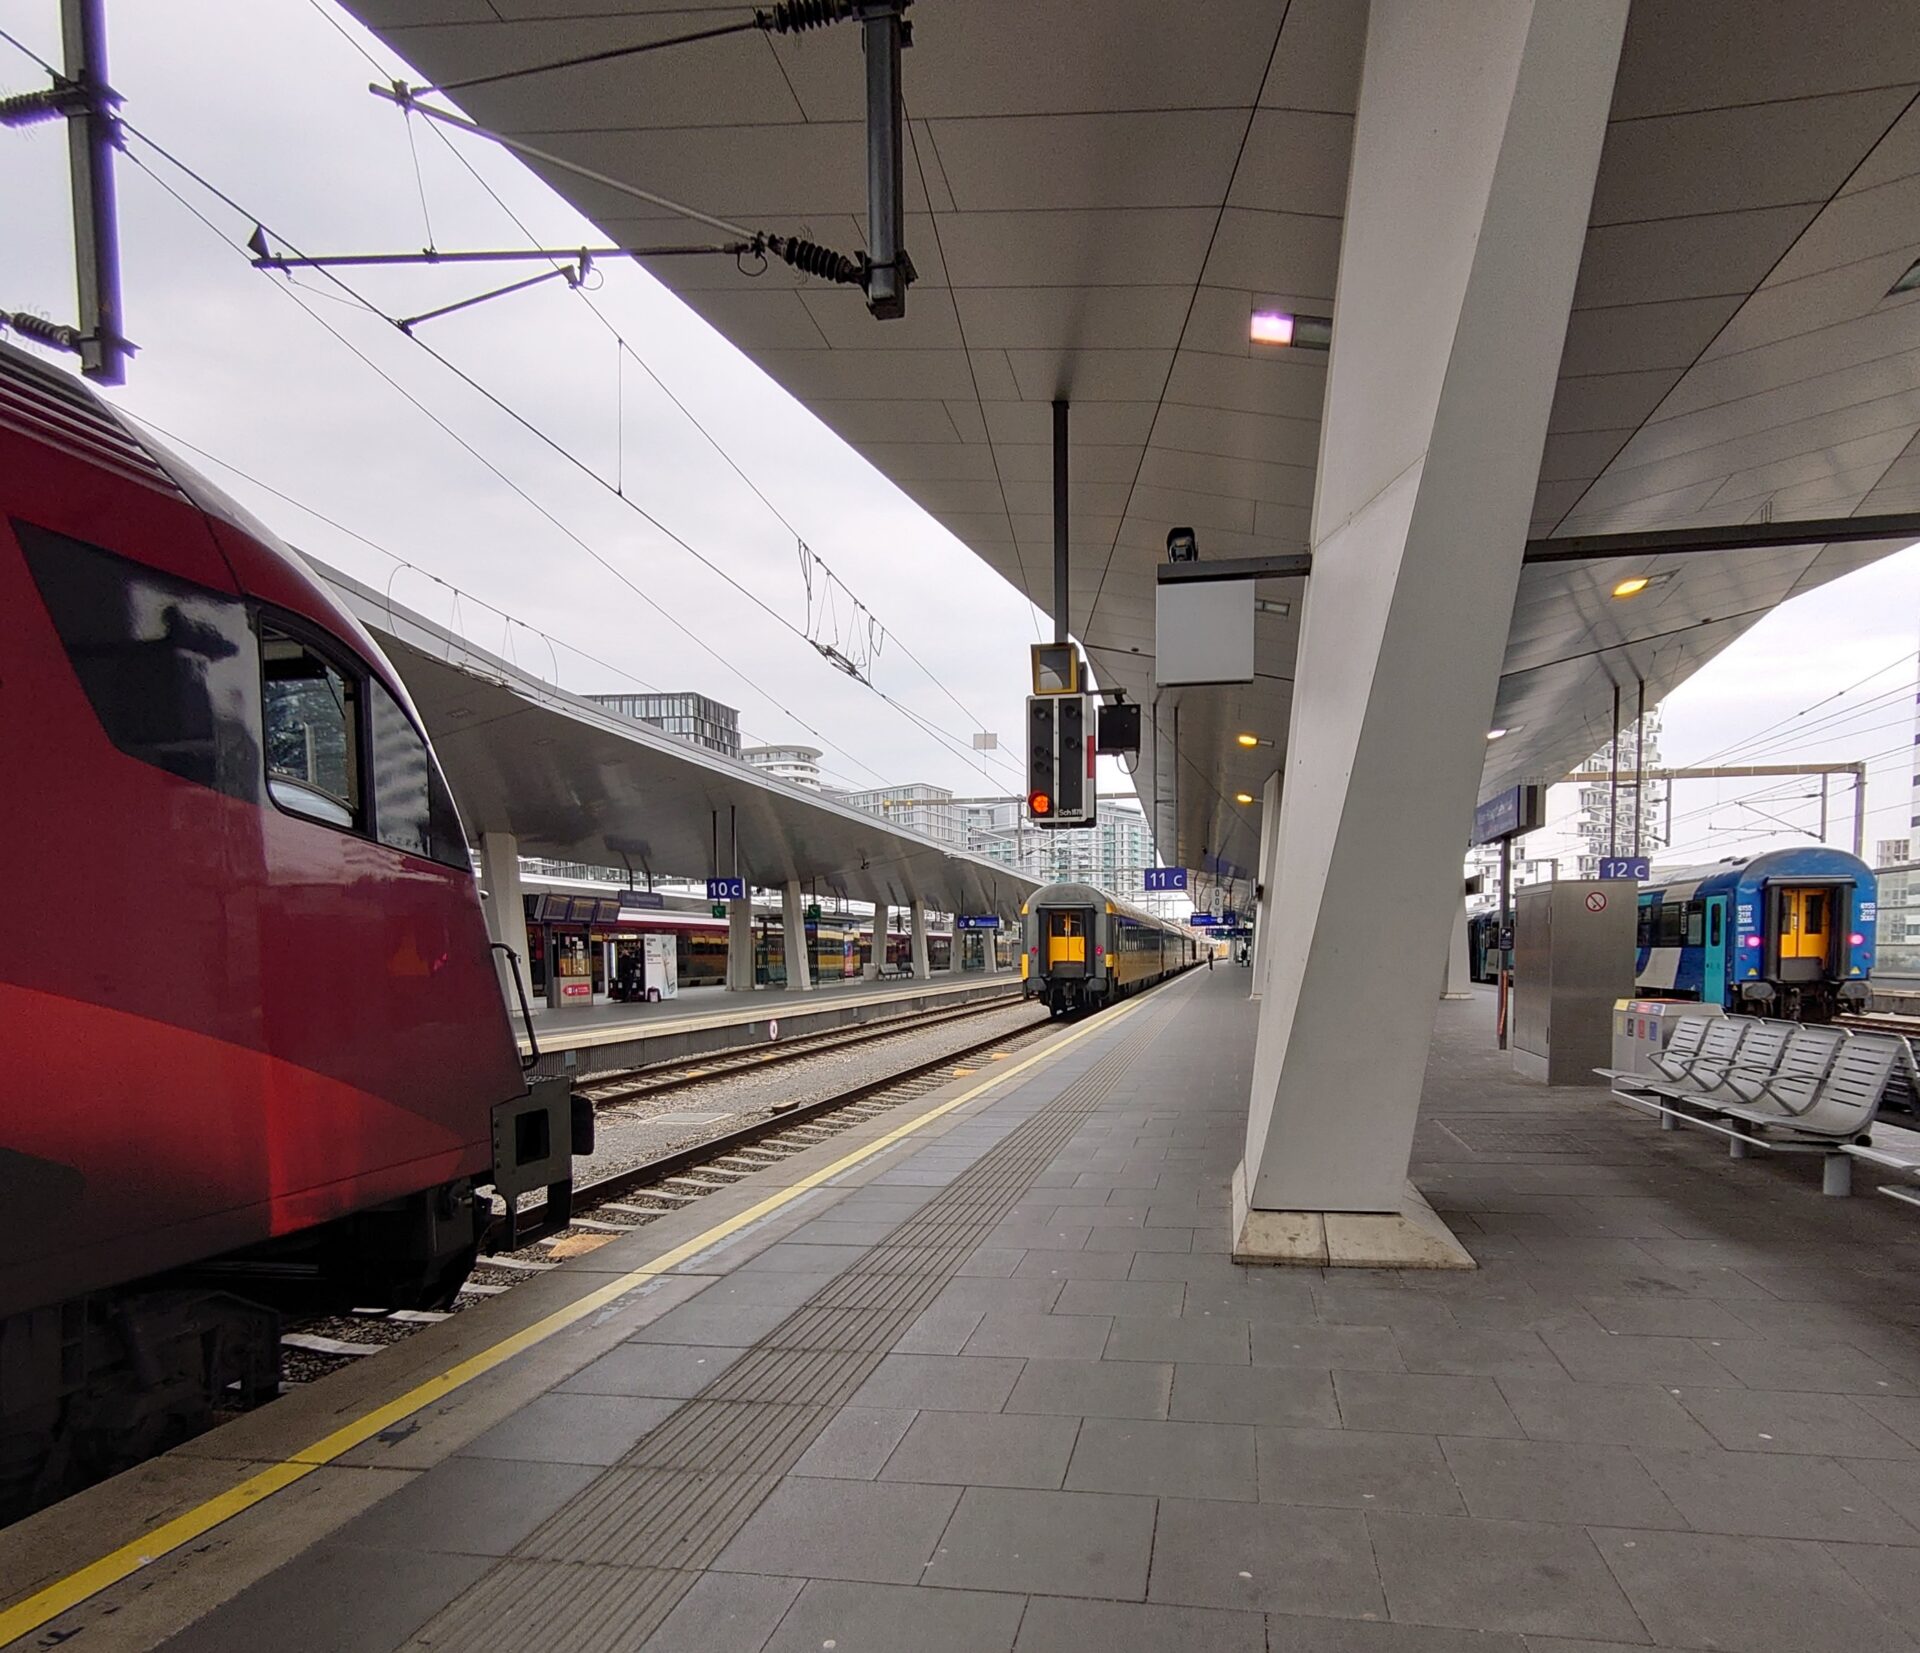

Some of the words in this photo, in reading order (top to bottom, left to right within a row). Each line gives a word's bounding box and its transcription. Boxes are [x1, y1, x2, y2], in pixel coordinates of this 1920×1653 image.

[1607, 862, 1628, 878] 12
[1150, 872, 1166, 887] 11
[710, 882, 728, 896] 10
